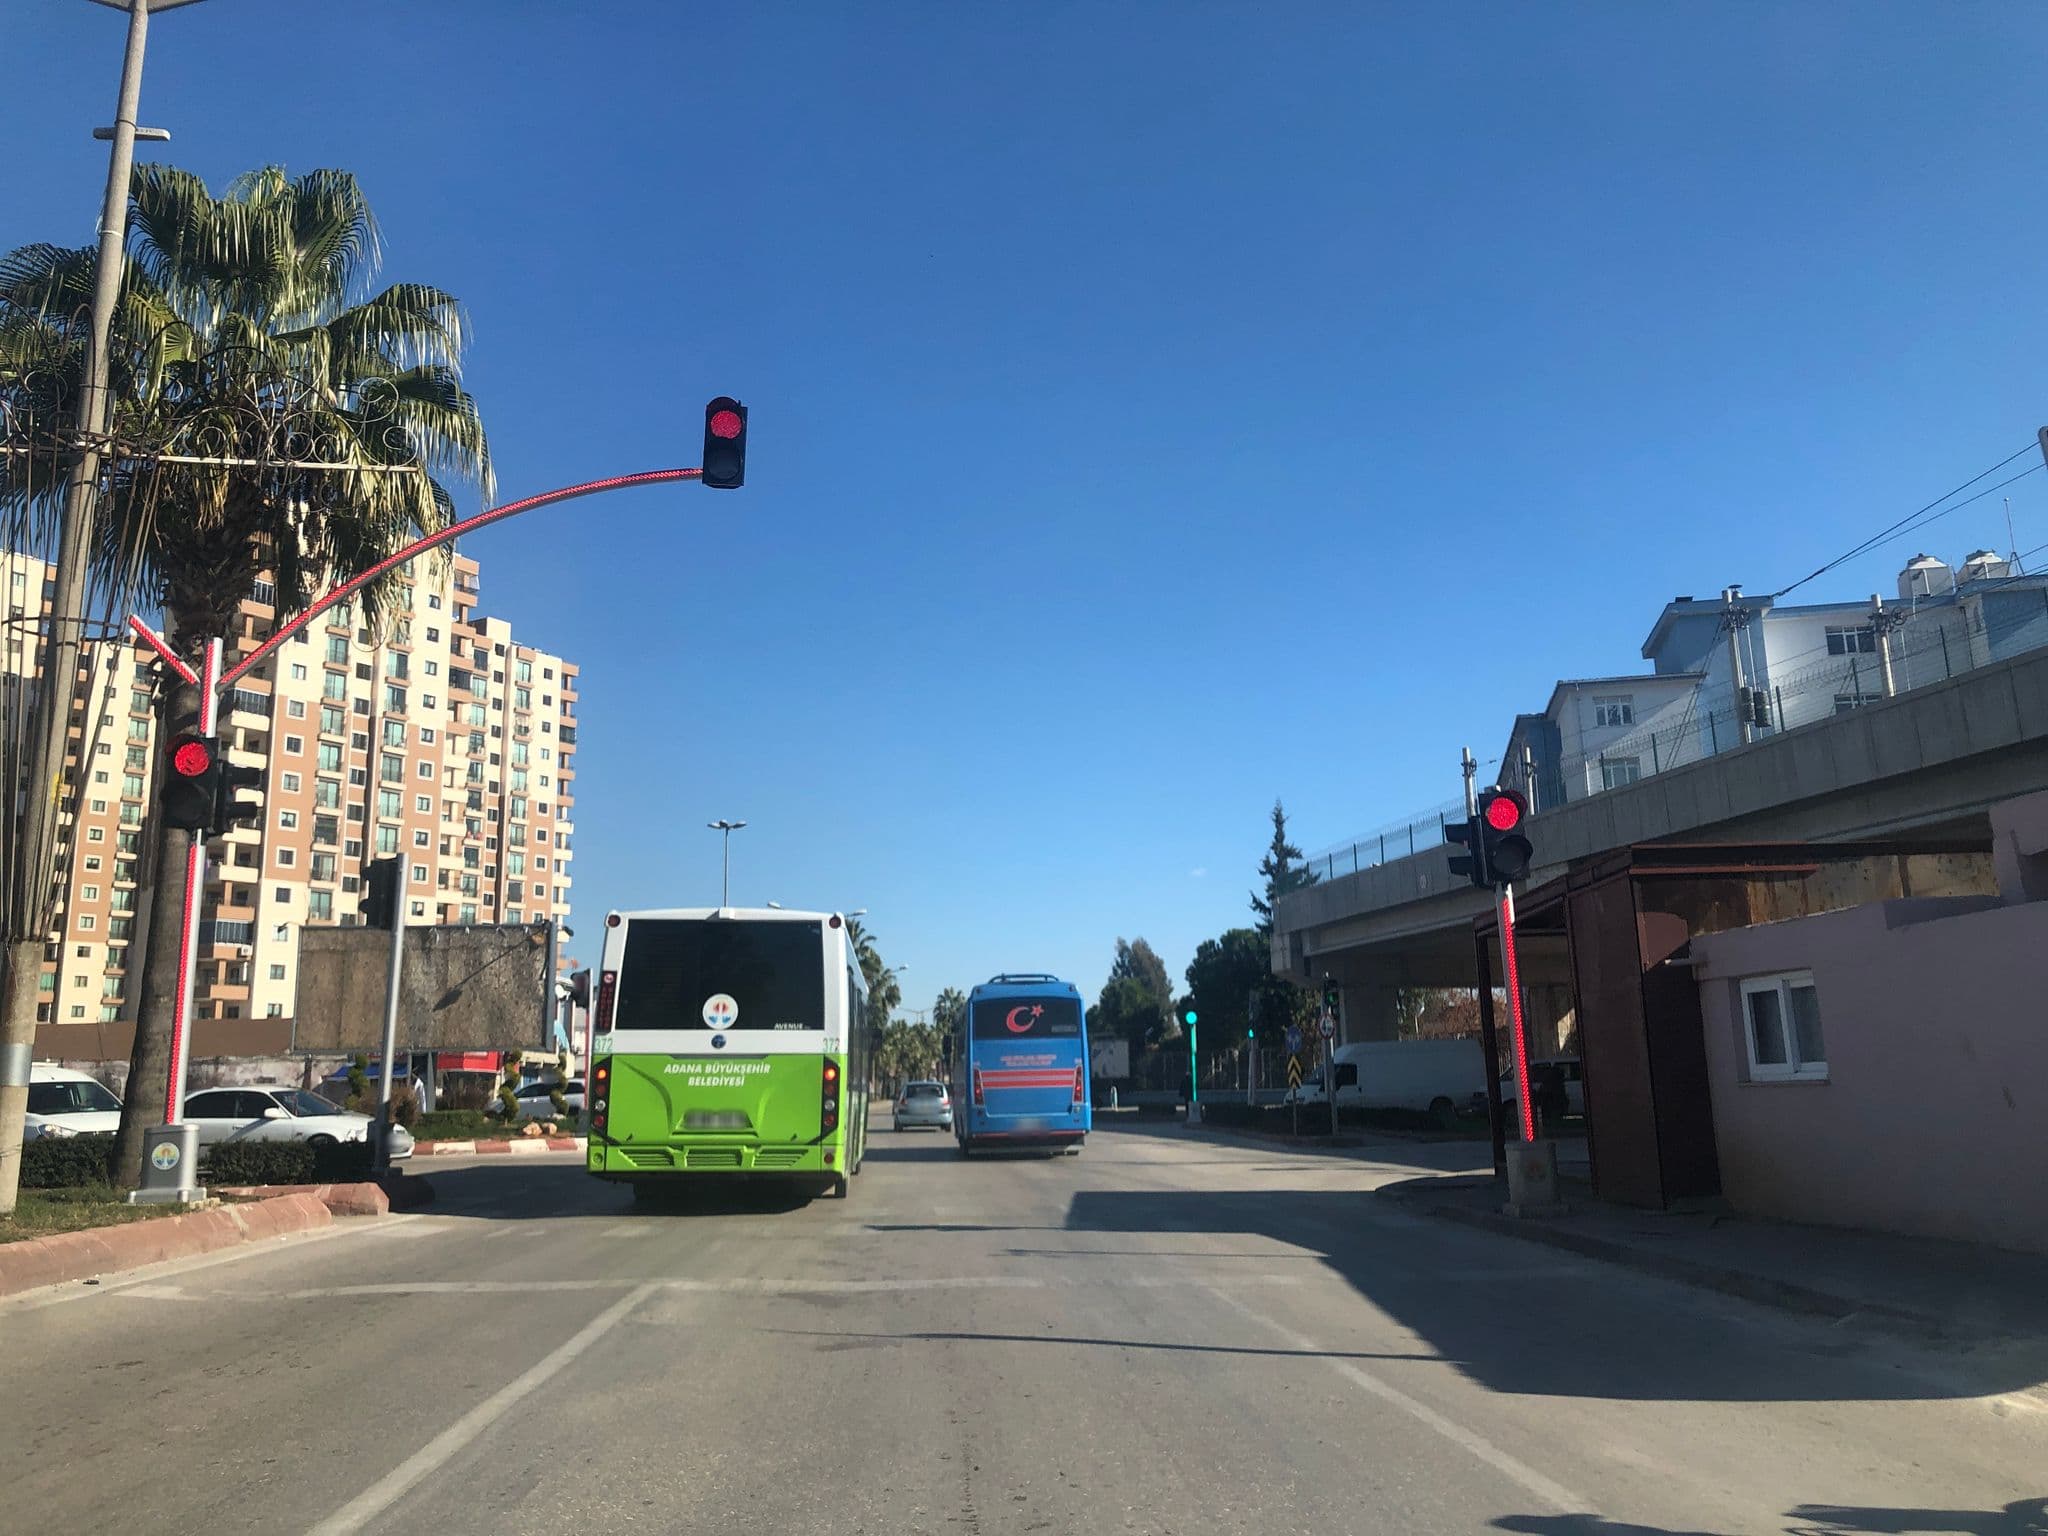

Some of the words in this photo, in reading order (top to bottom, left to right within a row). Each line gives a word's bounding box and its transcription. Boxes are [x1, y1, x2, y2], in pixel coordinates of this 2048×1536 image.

[595, 1038, 613, 1051] 372
[823, 1038, 840, 1052] 372
[664, 1063, 702, 1074] ADANA
[705, 1061, 771, 1075] BÜYÜKŞEHİR
[688, 1075, 746, 1087] BELEDİYESİ
